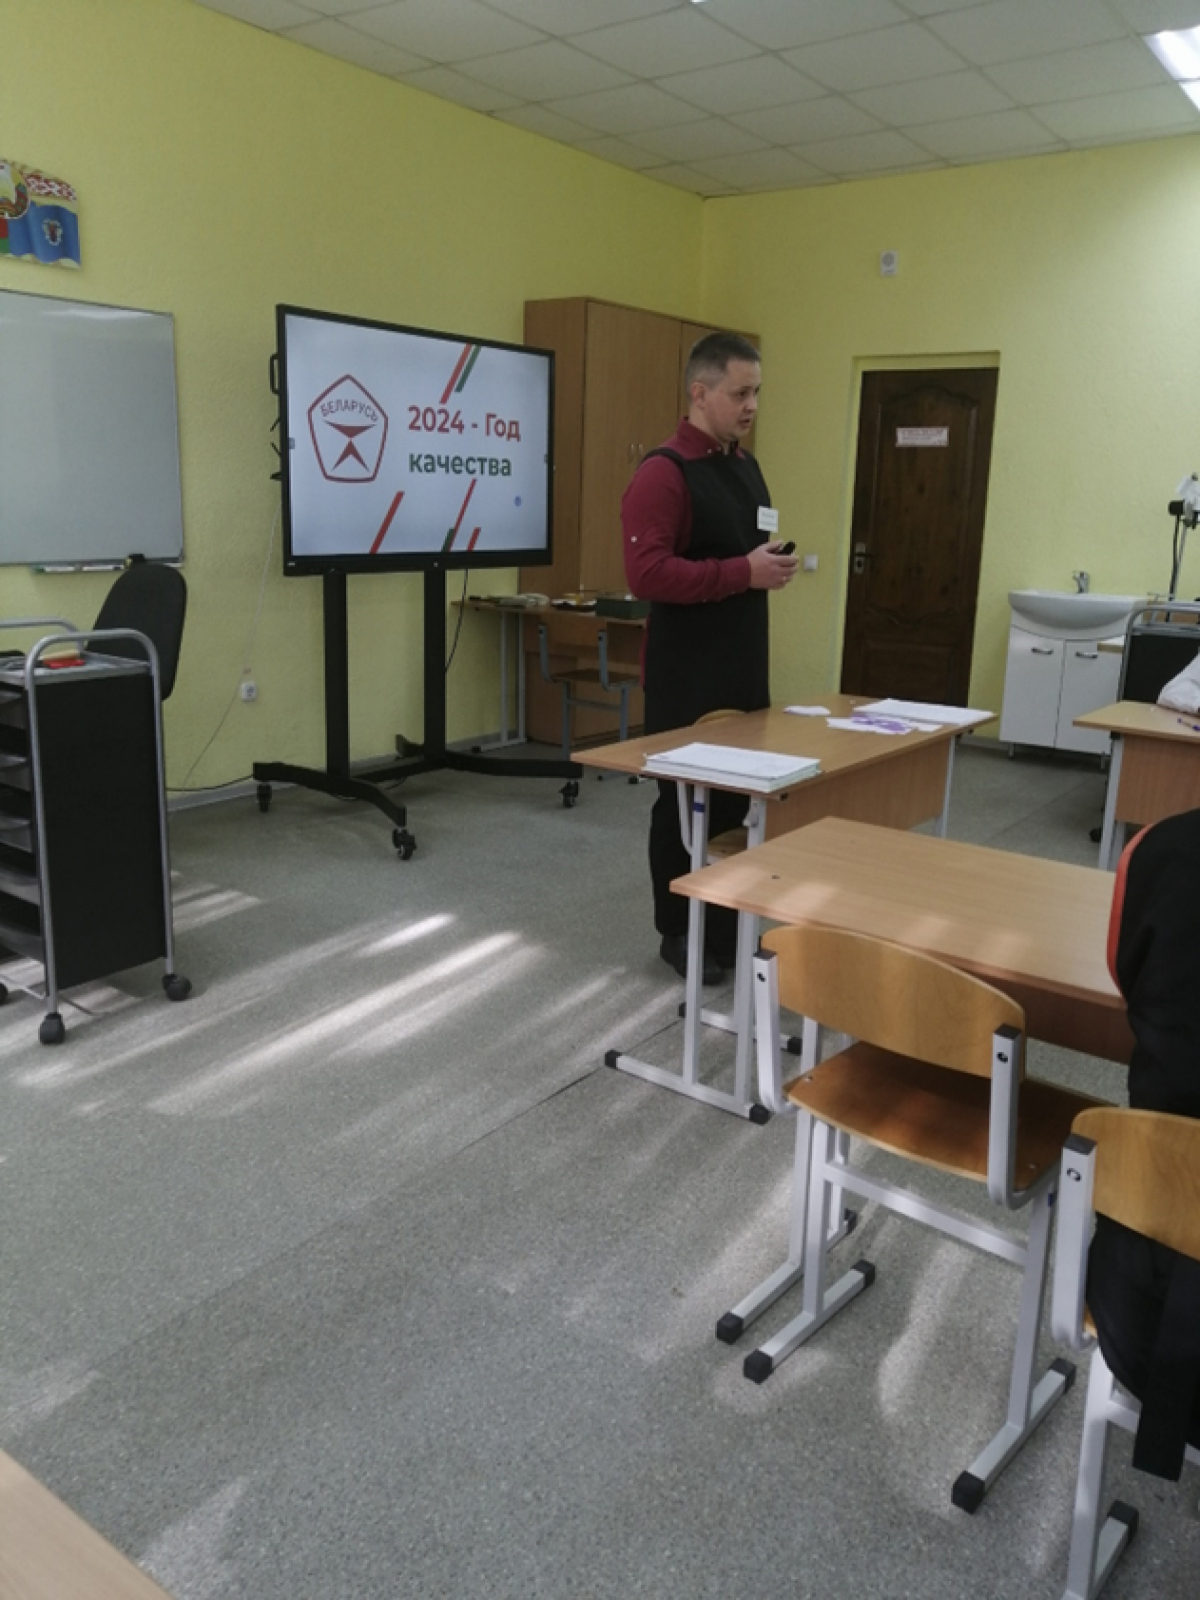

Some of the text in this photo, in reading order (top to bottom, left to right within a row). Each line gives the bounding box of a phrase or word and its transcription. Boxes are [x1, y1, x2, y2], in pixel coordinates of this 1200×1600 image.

[320, 399, 379, 422] БЕЛАРУСЬ
[407, 406, 465, 434] 2024
[485, 413, 521, 442] Год
[408, 453, 512, 477] качества
